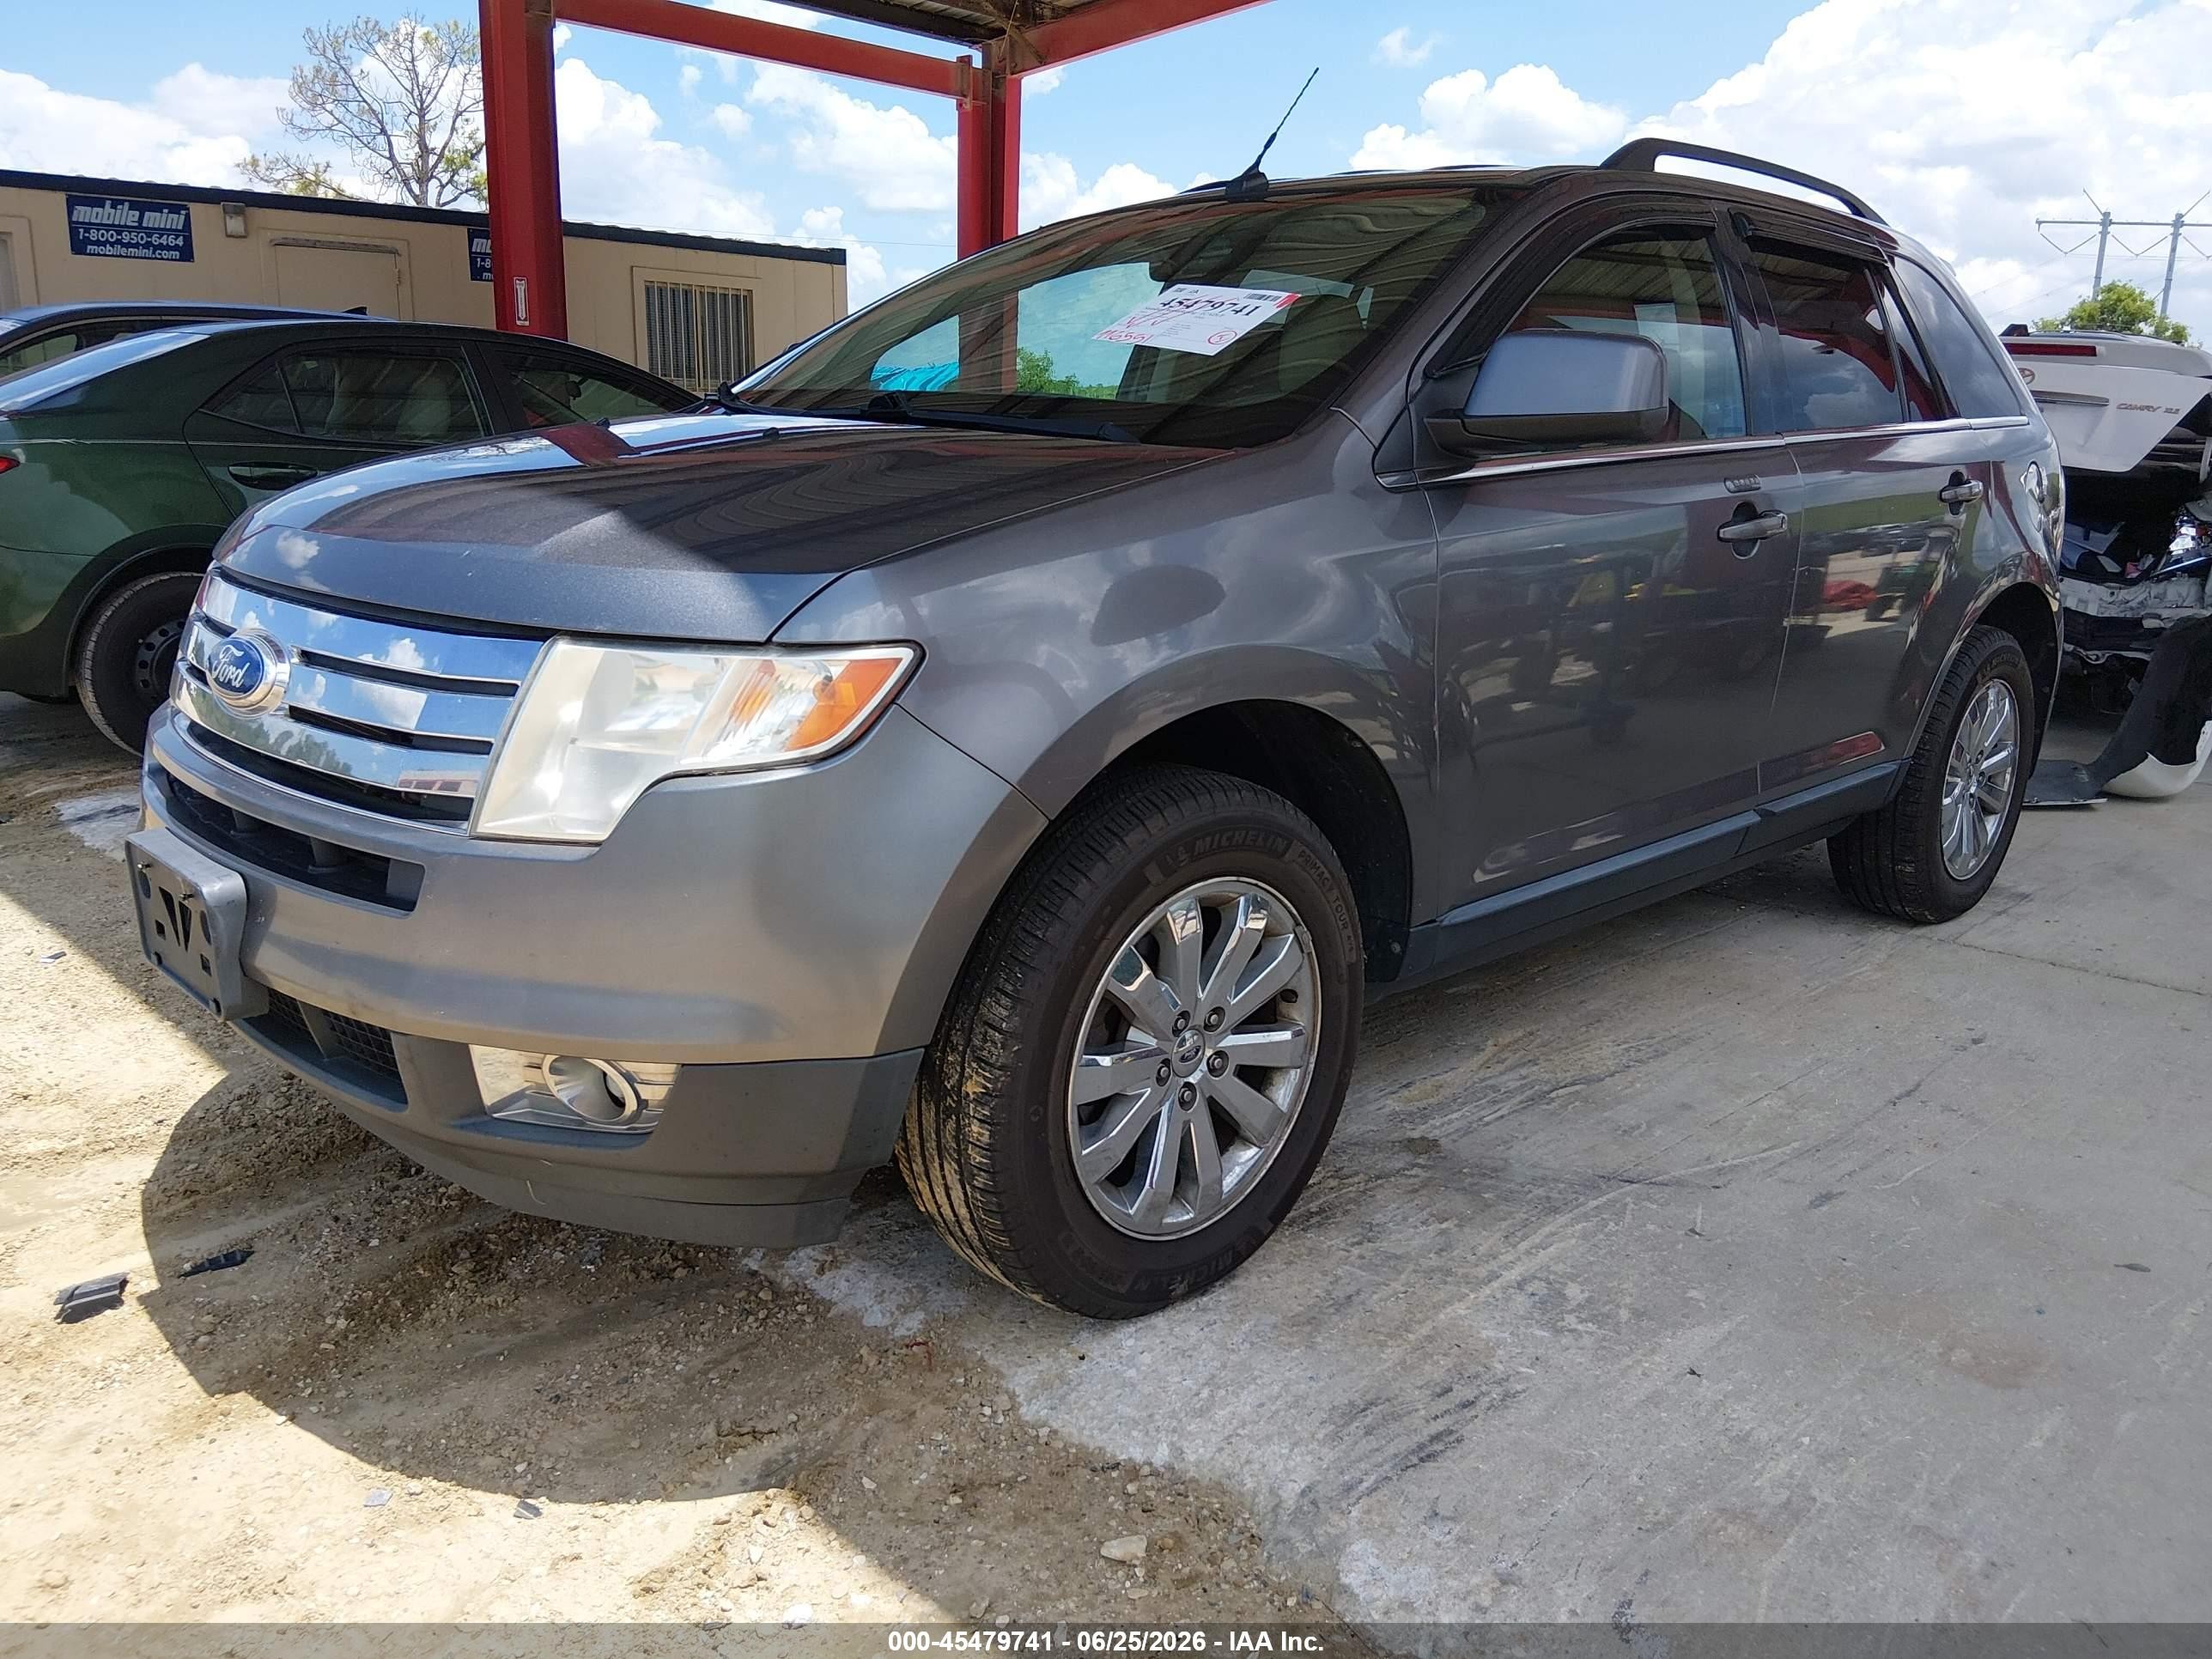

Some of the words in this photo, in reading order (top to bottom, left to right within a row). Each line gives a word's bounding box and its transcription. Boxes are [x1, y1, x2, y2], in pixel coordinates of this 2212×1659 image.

[72, 200, 140, 226] mobile
[142, 209, 188, 229] mini
[78, 228, 184, 246] 1-800-950-6464
[87, 244, 180, 259] mobilemini.com
[1159, 296, 1262, 316] 45479741
[2116, 403, 2162, 412] CAMRY
[211, 644, 250, 688] Ford
[1194, 830, 1287, 854] MICHELIN
[1332, 896, 1348, 931] TOUR
